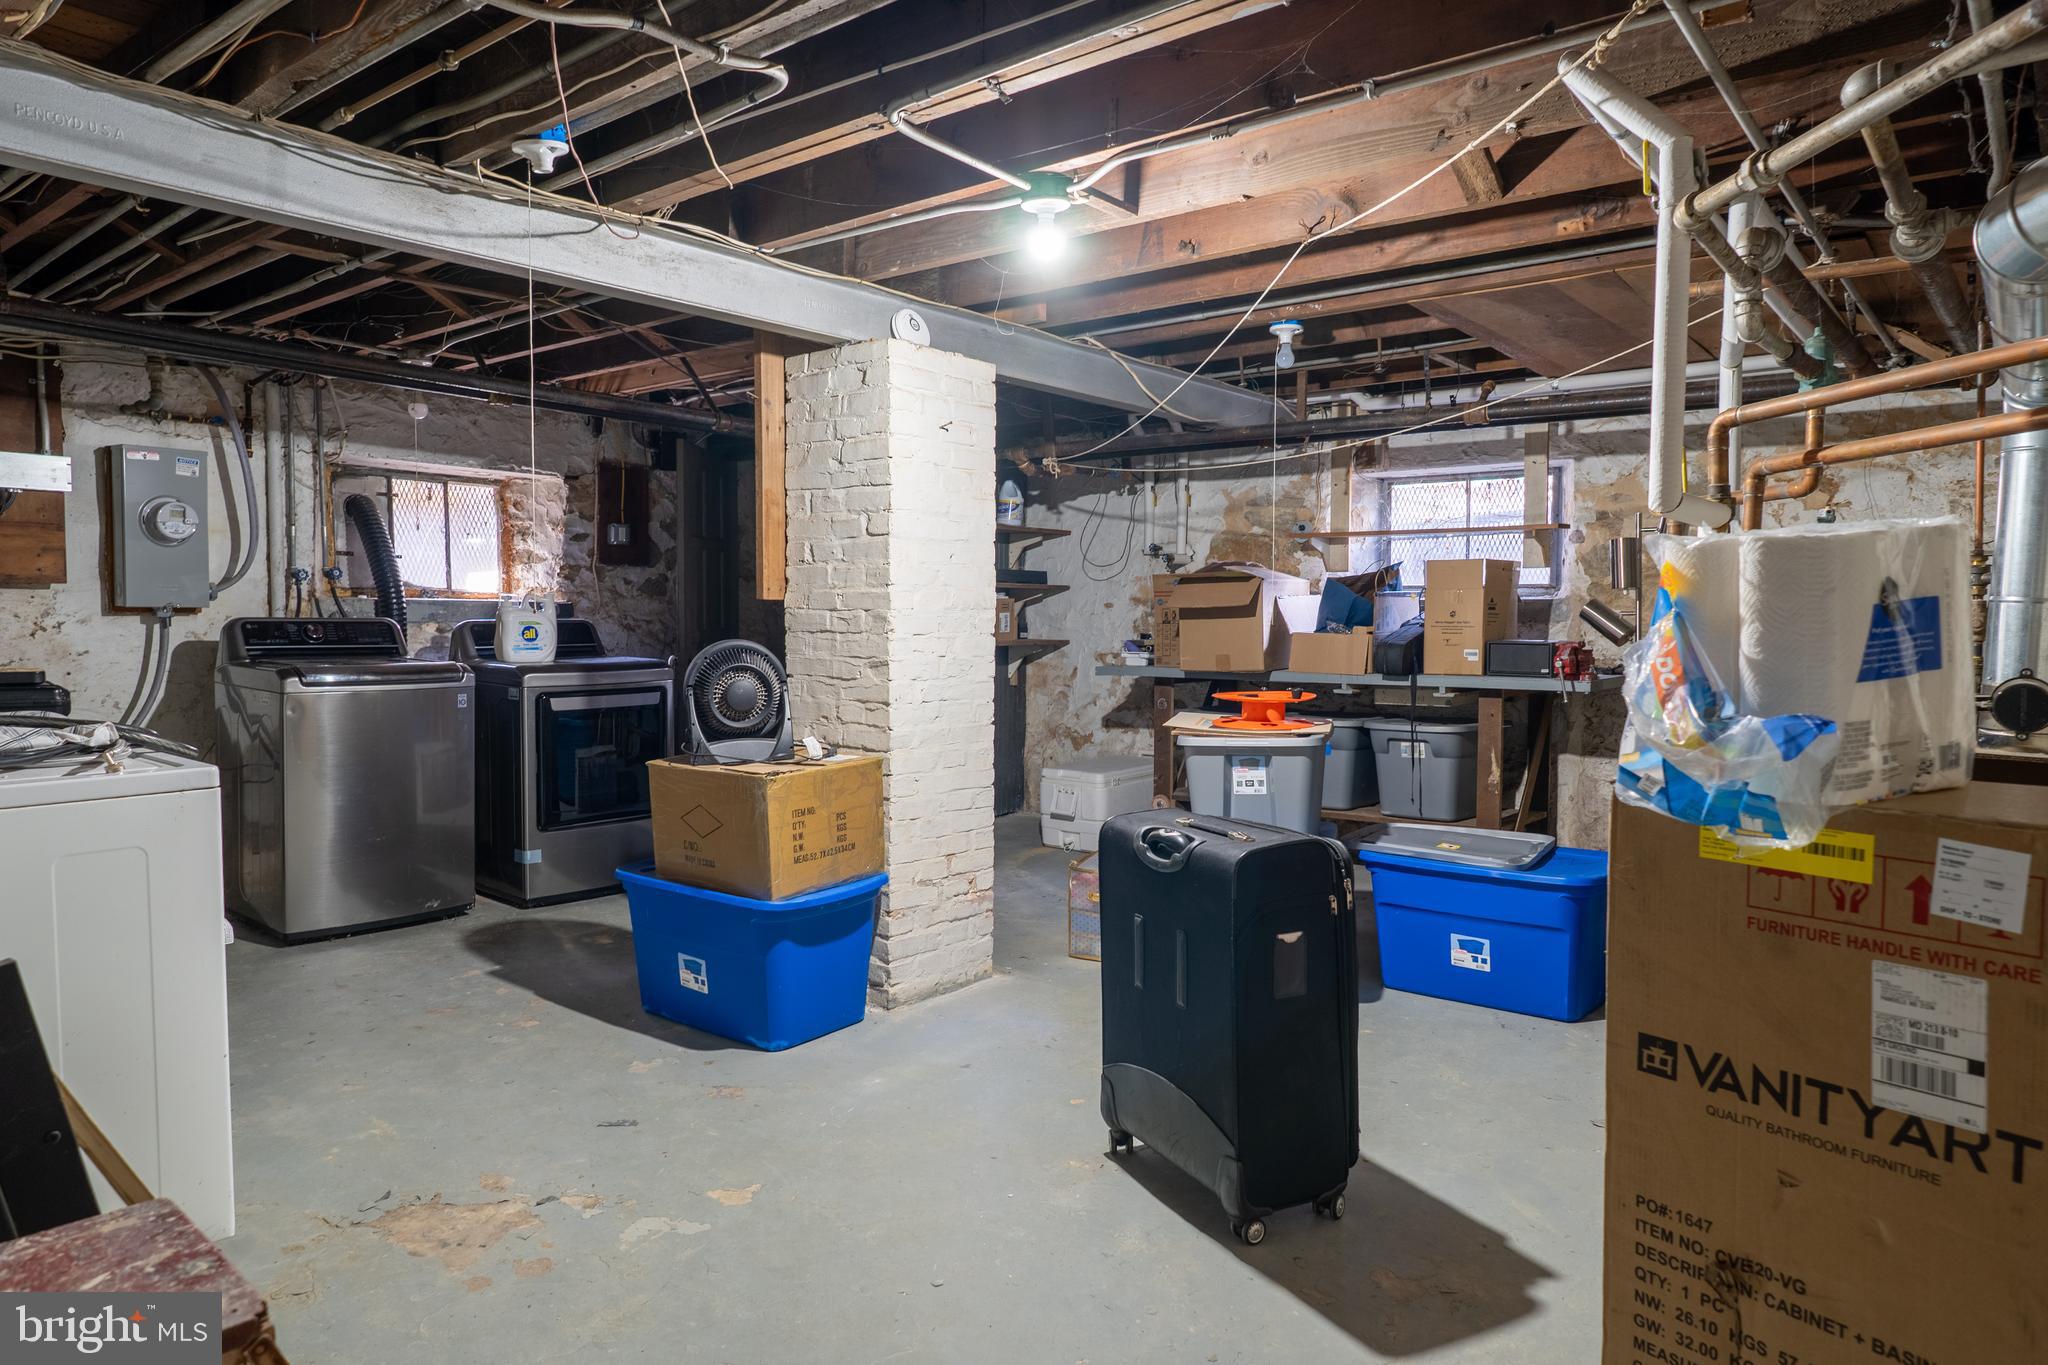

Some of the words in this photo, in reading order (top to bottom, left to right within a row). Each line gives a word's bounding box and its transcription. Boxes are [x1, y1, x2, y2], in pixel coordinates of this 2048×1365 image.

[15, 103, 83, 131] PENCOYD
[523, 628, 536, 639] all
[792, 808, 805, 819] ITEM
[836, 811, 847, 822] PCS
[836, 823, 847, 832] KGS
[837, 834, 847, 843] KGS
[1747, 916, 1841, 946] FURNITURE
[1847, 930, 1922, 962] HANDLE
[1927, 949, 1977, 973] WITH
[1983, 959, 2043, 985] CARE
[1706, 1104, 1763, 1130] QUALITY
[1765, 1121, 1847, 1157] BATHROOM
[1851, 1147, 1943, 1186] FURNITURE
[1675, 1210, 1713, 1234] 1647
[1635, 1218, 1674, 1244] ITEM
[1679, 1235, 1709, 1258] NO:
[1634, 1266, 1671, 1292] QTY:
[1682, 1286, 1689, 1300] 1
[1634, 1289, 1665, 1314] NW:
[1675, 1307, 1718, 1336] 26.10
[1764, 1293, 1848, 1339] CABINET
[1633, 1313, 1665, 1338] GW:
[1675, 1331, 1718, 1360] 32.00
